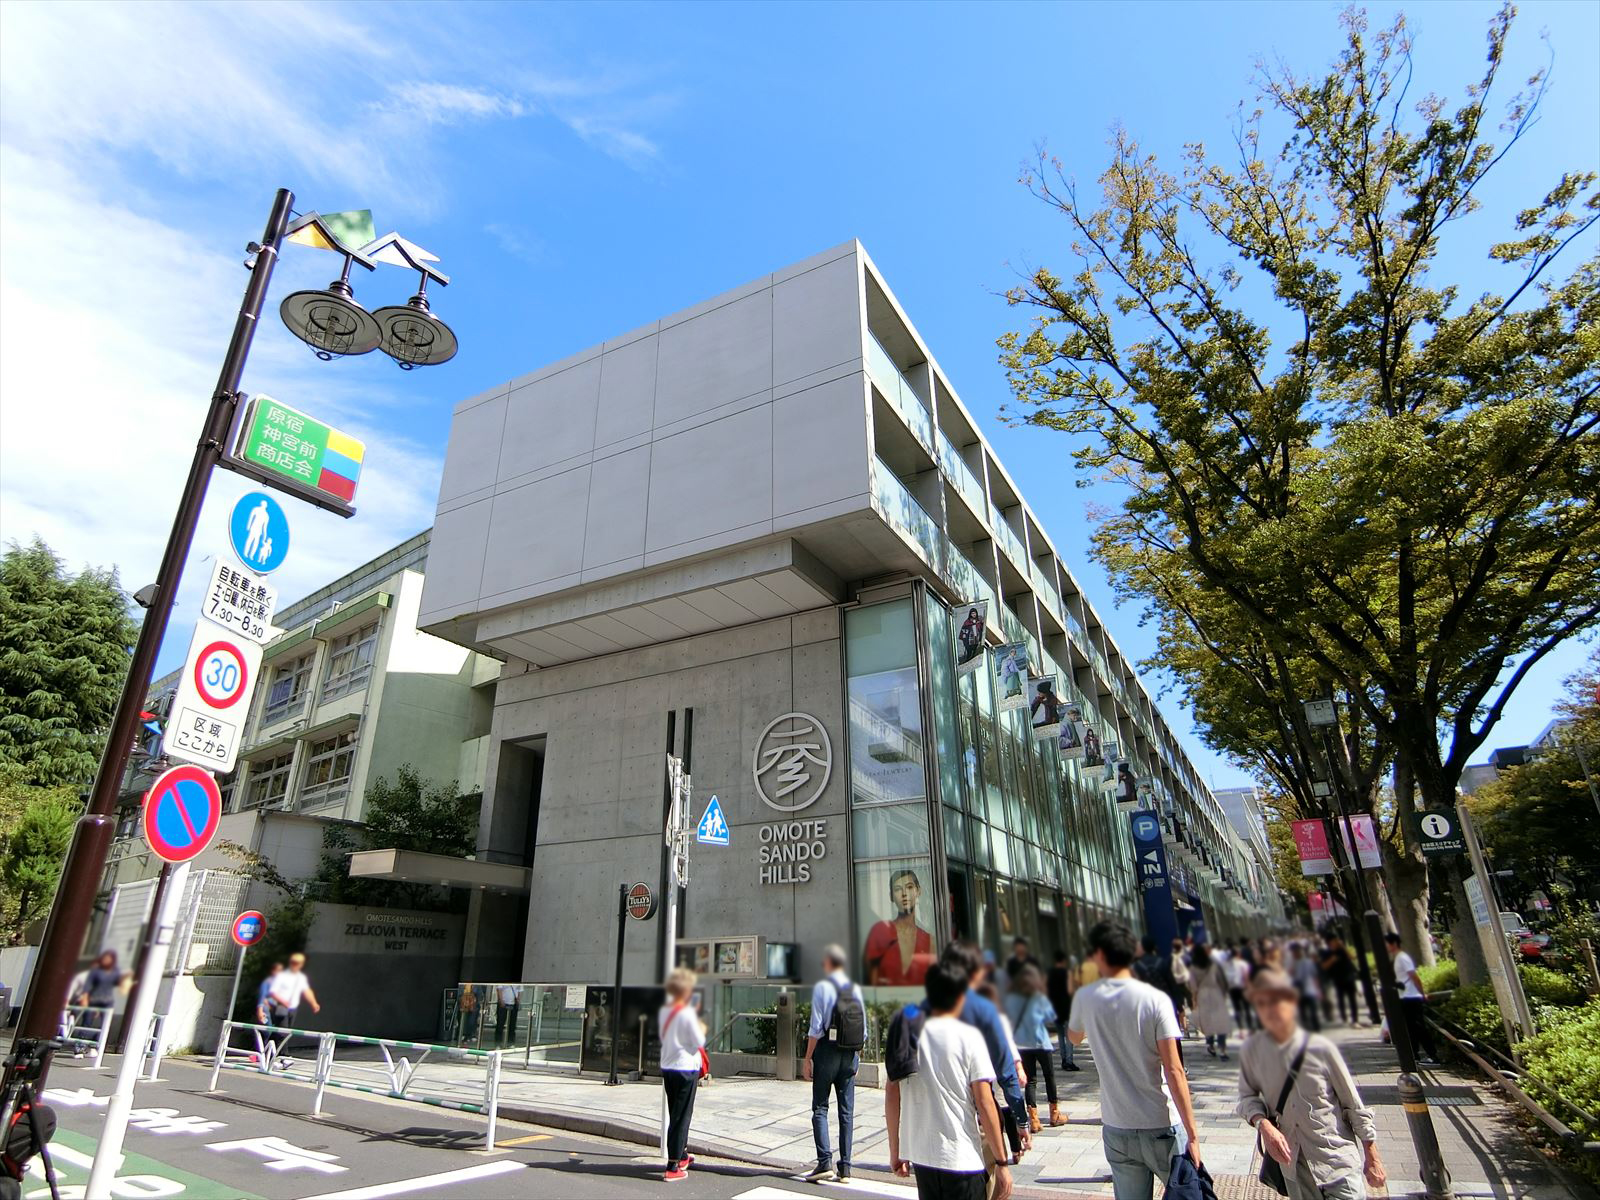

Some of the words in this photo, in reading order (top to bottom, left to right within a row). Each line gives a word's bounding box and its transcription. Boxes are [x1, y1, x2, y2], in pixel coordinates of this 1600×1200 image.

[266, 405, 305, 434] 原宿
[262, 423, 318, 460] 神宮前
[256, 441, 313, 478] 商店会
[219, 566, 272, 606] 自転車を除く
[206, 657, 237, 693] 30
[194, 717, 222, 738] 区域
[177, 731, 227, 759] ここから
[759, 820, 827, 843] OMOTE
[1139, 821, 1153, 835] P
[759, 840, 826, 864] SANDO
[759, 863, 811, 884] HILLS
[1143, 863, 1162, 875] IN
[366, 913, 414, 924] OMOTESANDO
[415, 917, 433, 926] HILLS
[344, 923, 396, 937] ZELKOVA
[400, 926, 448, 940] TERRACE
[384, 940, 409, 951] WEST
